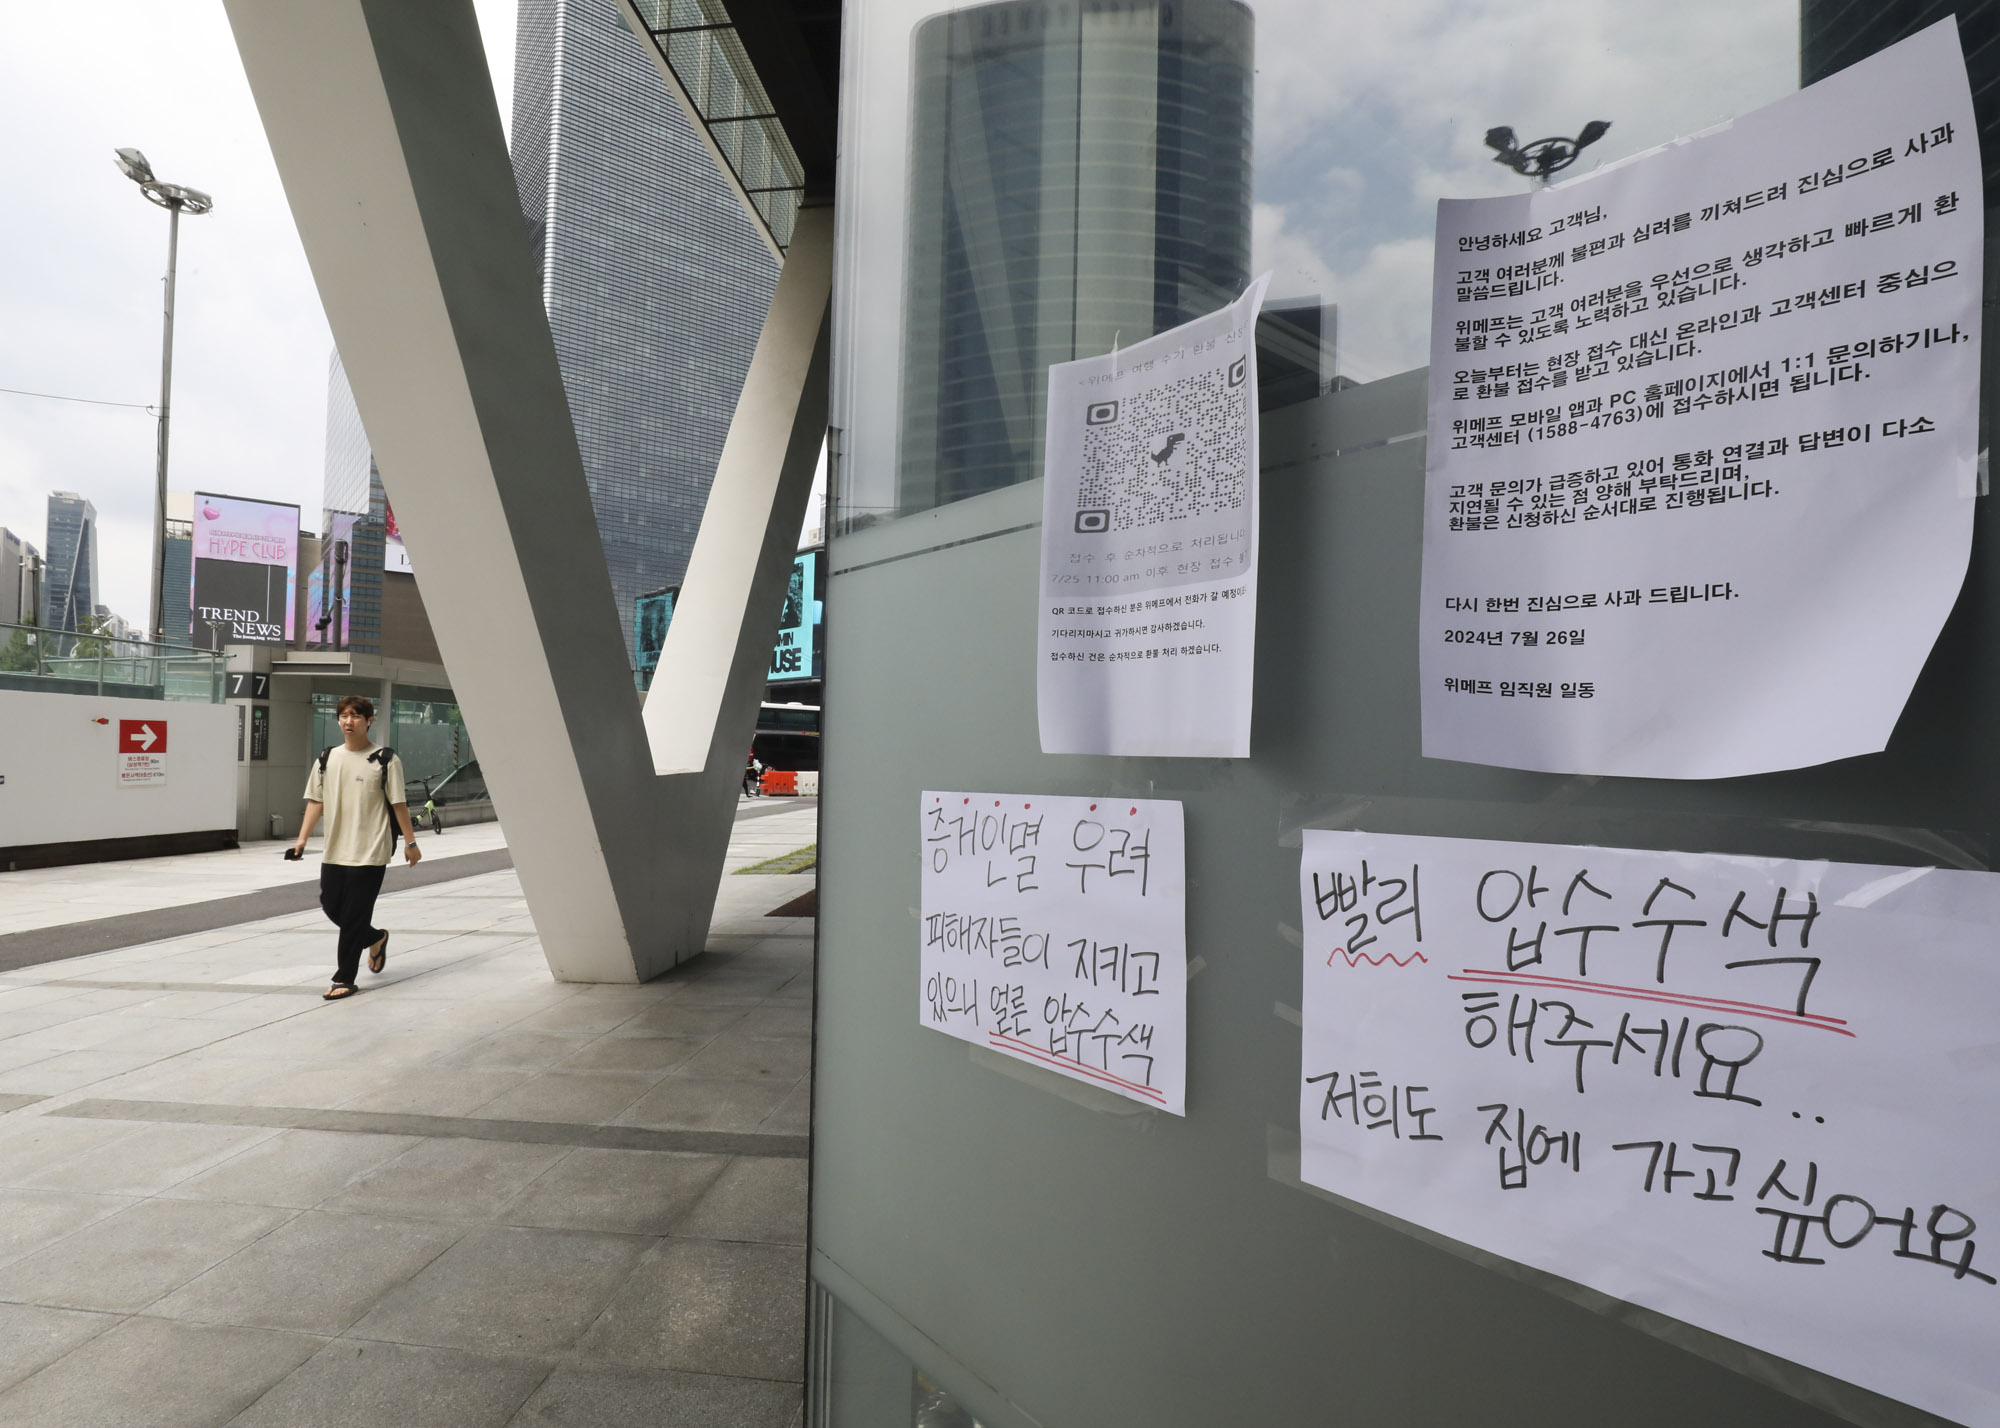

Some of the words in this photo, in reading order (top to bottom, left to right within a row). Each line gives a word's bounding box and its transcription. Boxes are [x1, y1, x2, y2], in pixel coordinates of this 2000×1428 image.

[1456, 268, 1490, 284] 고객
[1496, 251, 1565, 281] 여러분께
[1571, 232, 1626, 263] 불편과
[1632, 212, 1693, 244] 심려를
[1700, 182, 1788, 222] 끼쳐드려
[1797, 147, 1896, 195] 진심으로
[1904, 121, 1955, 157] 사과
[1458, 227, 1543, 252] 안녕하세요
[1549, 205, 1608, 236] 고객님,
[1455, 314, 1524, 336] 위메프는
[1529, 302, 1564, 325] 고객
[1570, 280, 1643, 313] 여러분을
[1650, 256, 1733, 292] 우선으로
[1742, 228, 1835, 268] 생각하고
[1844, 202, 1922, 238] 빠르게
[1934, 191, 1960, 216] 환
[1456, 270, 1565, 302] 말씀드립니다.
[1453, 361, 1540, 384] 오늘부터는
[1547, 350, 1581, 373] 현장
[1587, 339, 1623, 363] 접수
[1629, 327, 1668, 350] 대신
[1675, 303, 1762, 341] 온라인과
[1769, 279, 1867, 318] 고객센터
[1876, 259, 1959, 294] 중심으
[1454, 334, 1489, 352] 불할
[1494, 331, 1512, 348] 수
[1518, 318, 1570, 345] 있도록
[1575, 296, 1649, 330] 노력하고
[1656, 272, 1747, 310] 있습니다.
[1452, 386, 1470, 401] 로
[1476, 381, 1510, 400] 환불
[1517, 370, 1569, 395] 접수를
[1575, 360, 1610, 382] 받고
[1617, 339, 1703, 373] 있습니다.
[1452, 415, 1503, 435] 위메프
[1509, 405, 1562, 428] 모바일
[1568, 396, 1603, 420] 앱과
[1610, 389, 1637, 408] PC
[1643, 359, 1771, 403] 홈페이지에서
[1780, 351, 1815, 373] 1:1
[1825, 322, 1970, 366] 문의하기나,
[1451, 429, 1520, 450] 고객센터
[1672, 377, 1780, 416] 접수하시면
[1789, 362, 1871, 393] 됩니다.
[1449, 482, 1484, 499] 고객
[1489, 477, 1543, 496] 문의가
[1548, 465, 1620, 492] 급증하고
[1626, 456, 1665, 479] 있어
[1672, 448, 1714, 472] 통화
[1722, 437, 1789, 465] 연결과
[1798, 423, 1872, 453] 답변이
[1882, 415, 1936, 439] 다소
[1448, 514, 1500, 531] 환불은
[1506, 507, 1576, 529] 신청하신
[1582, 496, 1657, 521] 순서대로
[1664, 479, 1780, 511] 진행됩니다.
[1449, 498, 1500, 516] 지연될
[1506, 496, 1524, 512] 수
[1530, 493, 1566, 511] 있는
[1572, 487, 1589, 505] 점
[1595, 480, 1632, 501] 양해
[1638, 464, 1750, 495] 부탁드리며,
[208, 537, 248, 557] HYPE
[252, 542, 287, 560] CLUB
[1051, 574, 1080, 584] 7/25
[1087, 574, 1120, 584] 11:00
[1123, 572, 1140, 582] am
[1146, 565, 1169, 578] 이후
[1177, 561, 1201, 575] 현장
[1209, 555, 1234, 570] 접수
[1069, 552, 1096, 564] 접수
[1105, 552, 1117, 564] 후
[1124, 541, 1184, 561] 순차적으로
[199, 606, 260, 623] TREND
[1051, 607, 1065, 616] QR
[1067, 606, 1094, 615] 코드로
[1097, 604, 1127, 616] 접수하신
[1130, 602, 1143, 613] 분은
[1145, 596, 1182, 610] 위메프에서
[1184, 592, 1208, 605] 전화가
[1210, 591, 1219, 602] 갈
[1445, 596, 1479, 612] 다시
[1485, 596, 1520, 612] 한번
[1526, 592, 1598, 613] 진심으로
[1604, 588, 1642, 608] 사과
[1648, 582, 1740, 604] 드립니다.
[232, 621, 282, 637] NEWS
[1051, 629, 1112, 639] 기다리지마시고
[1115, 625, 1148, 638] 귀가하시면
[1051, 652, 1085, 661] 접수하신
[1088, 652, 1106, 662] 건은
[1109, 650, 1143, 662] 순차적으로
[1145, 648, 1159, 659] 환불
[1162, 647, 1178, 657] 처리
[1180, 643, 1222, 656] 하겠습니다.
[1444, 629, 1504, 646] 2024년
[1510, 630, 1539, 647] 7월
[1546, 629, 1586, 646] 26일
[231, 674, 244, 694] 7
[255, 675, 267, 695] 7
[1443, 677, 1493, 695] 위메프
[1499, 681, 1552, 699] 임직원
[1560, 681, 1596, 699] 일동
[927, 806, 1044, 893] 증거인멸
[1065, 819, 1151, 896] 우려
[925, 911, 1050, 970] 피해자들이
[1067, 938, 1160, 997] 지키고
[1312, 859, 1424, 956] 빨리
[1476, 864, 1822, 1018] 압수수색
[927, 971, 979, 1027] 있으니
[990, 983, 1032, 1037] 얼른
[1043, 992, 1154, 1087] 압수수색
[1306, 1070, 1444, 1142] 저희도
[1476, 1103, 1581, 1191] 집에
[1612, 1139, 1743, 1201] 가고
[1755, 1159, 1998, 1285] 싶어요
